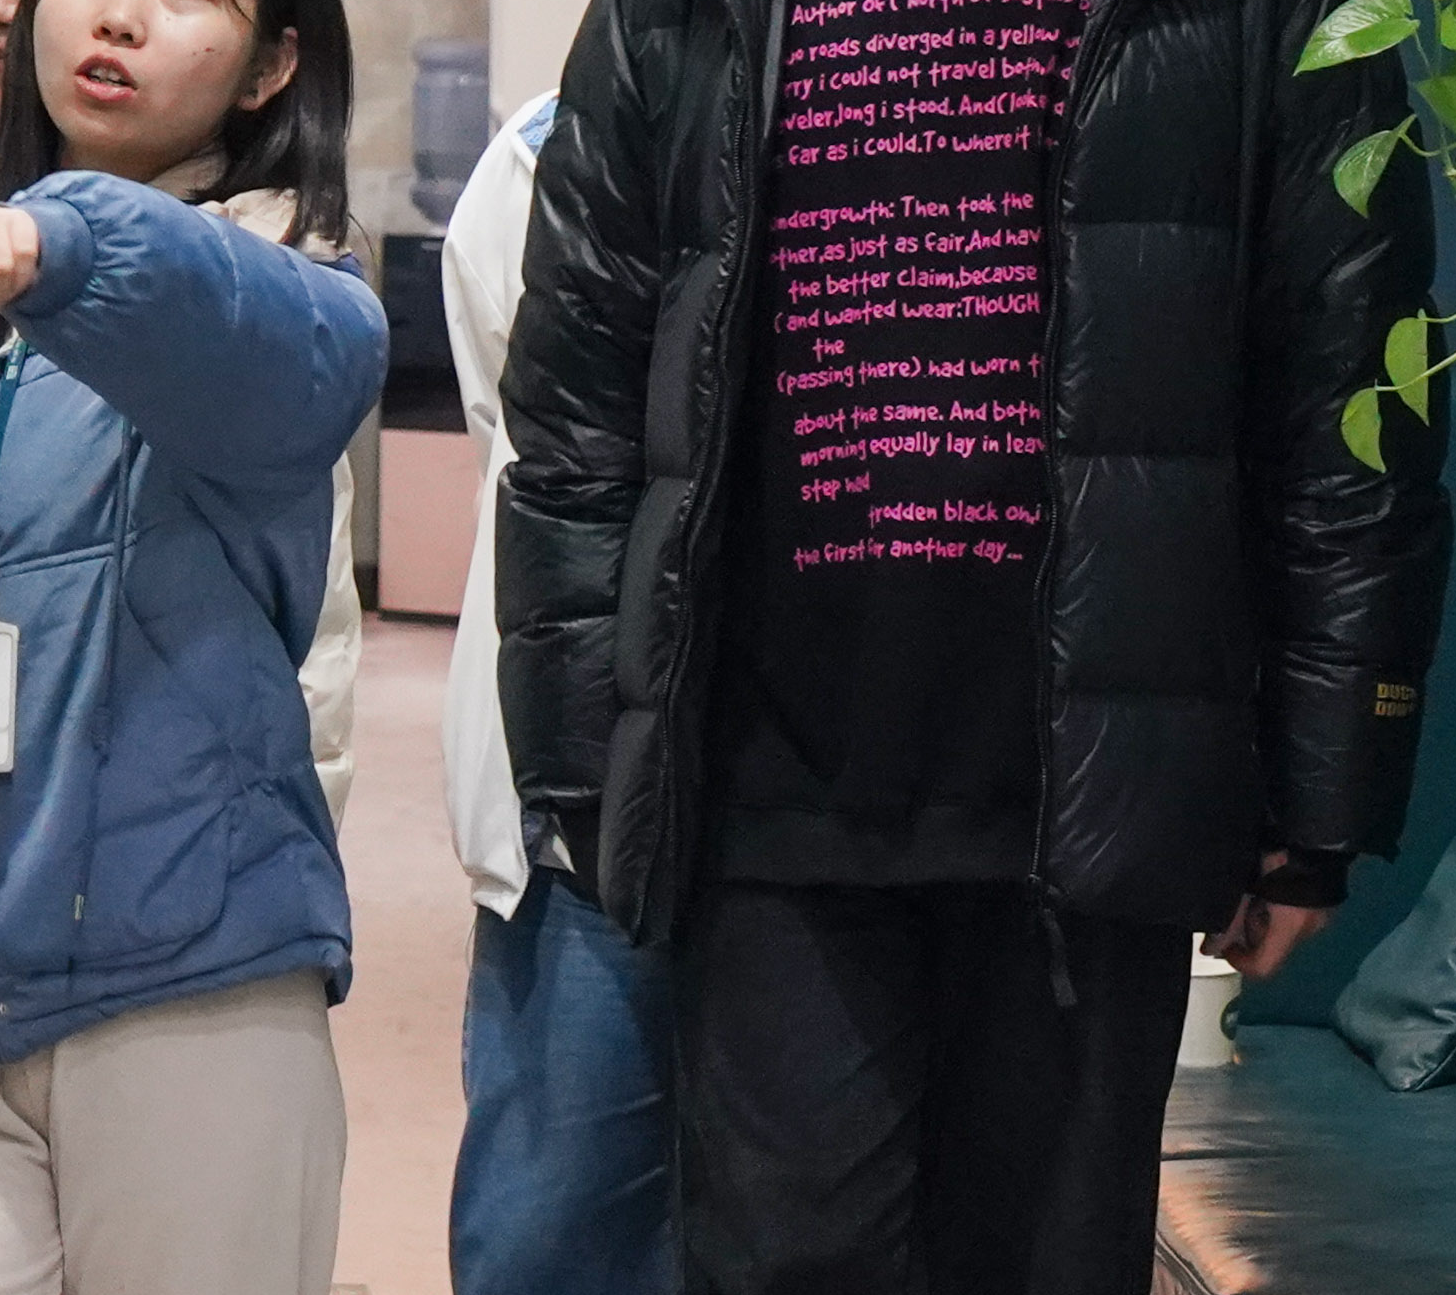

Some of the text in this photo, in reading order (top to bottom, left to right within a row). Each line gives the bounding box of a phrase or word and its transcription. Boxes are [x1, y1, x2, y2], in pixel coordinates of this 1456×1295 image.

[791, 2, 857, 26] Author
[809, 37, 861, 62] roads
[866, 28, 955, 55] diverged
[959, 26, 977, 45] in
[983, 29, 996, 46] a
[997, 24, 1060, 50] yellow
[830, 65, 881, 90] could
[887, 63, 921, 88] not
[929, 57, 995, 87] travel
[893, 97, 955, 124] stood.
[788, 144, 821, 166] far
[826, 143, 849, 161] as
[900, 195, 950, 218] Then
[957, 193, 996, 222] took
[1001, 191, 1034, 217] the
[847, 234, 888, 262] just
[894, 236, 919, 253] as
[788, 279, 821, 304] the
[826, 270, 891, 297] better
[824, 299, 896, 325] wanted
[812, 337, 845, 363] the
[776, 366, 854, 396] (passing
[858, 356, 922, 385] there)
[928, 359, 965, 378] had
[970, 357, 1020, 376] worn
[793, 400, 1041, 435] about the same. And both
[800, 439, 866, 466] morning
[869, 431, 940, 458] equally
[946, 431, 976, 458] lay
[982, 435, 999, 454] in
[800, 478, 841, 503] step
[868, 502, 938, 529] trodden
[943, 499, 999, 523] black
[793, 547, 821, 573] the
[823, 539, 865, 563] first
[889, 537, 968, 564] another
